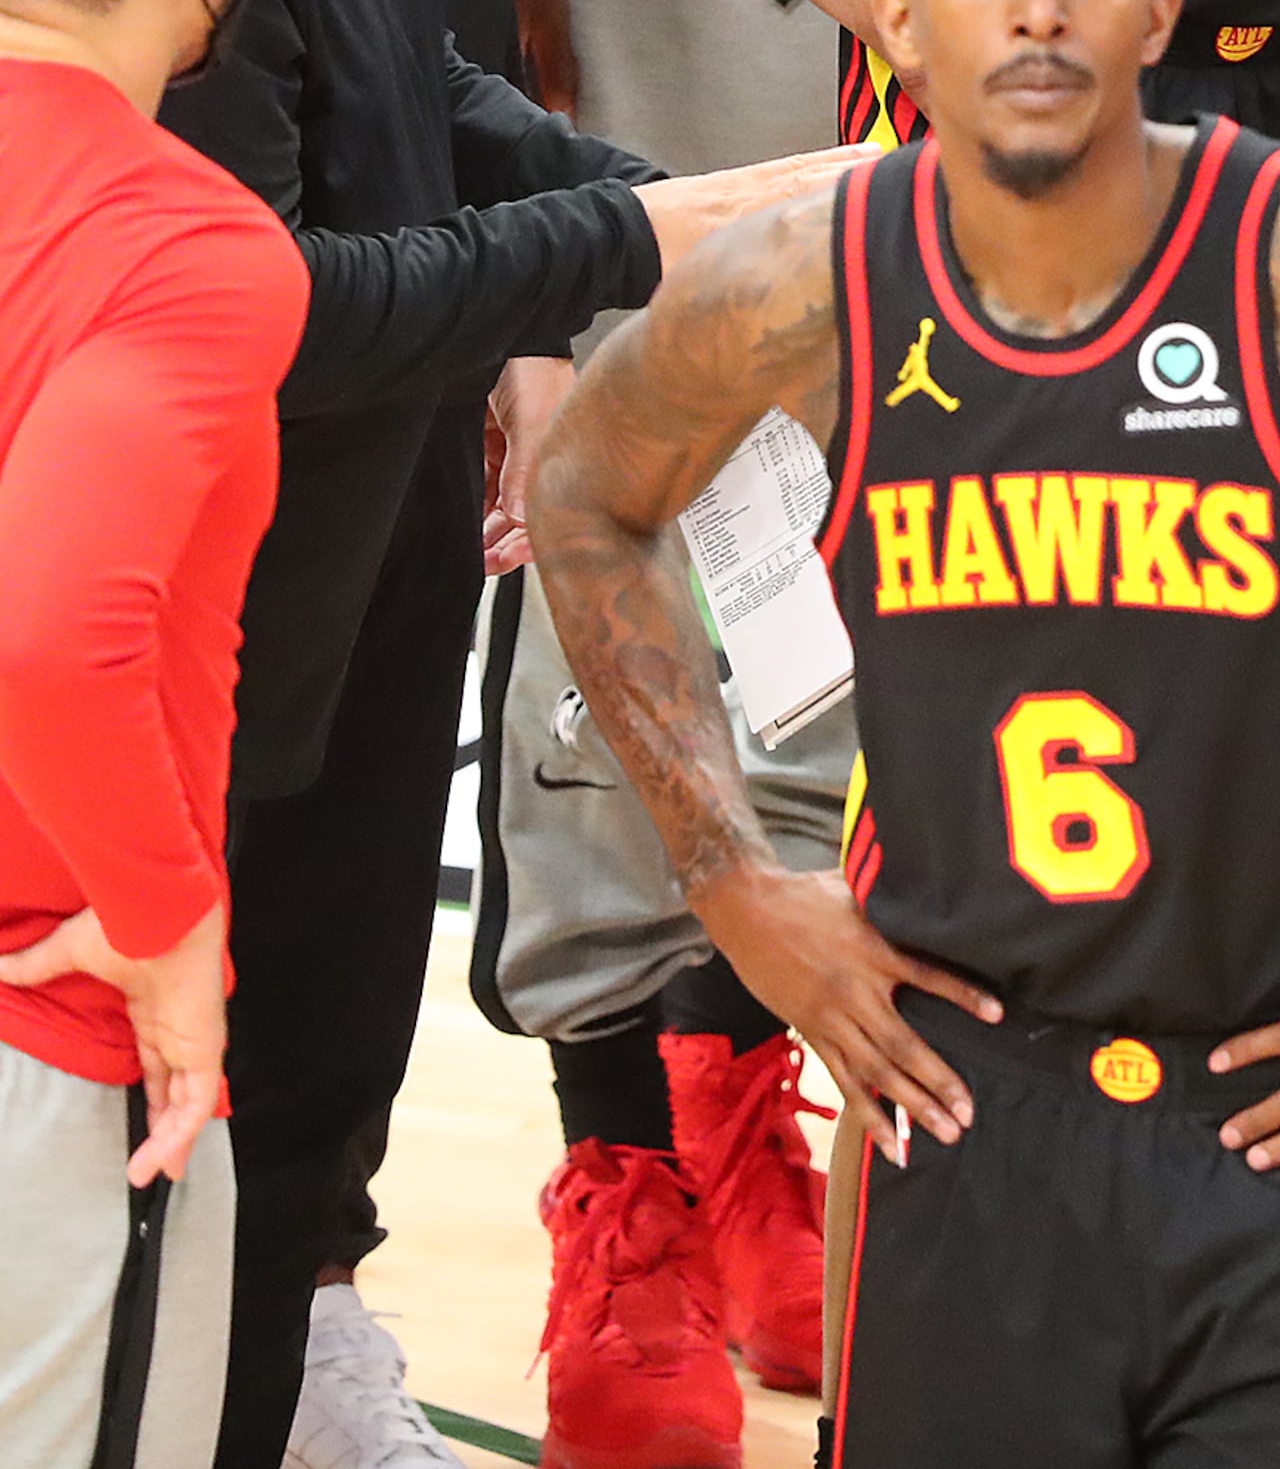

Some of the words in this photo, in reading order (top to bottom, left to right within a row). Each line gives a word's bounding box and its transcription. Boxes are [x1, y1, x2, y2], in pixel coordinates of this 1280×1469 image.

[1223, 26, 1264, 46] ATL
[1124, 406, 1240, 432] sharecare
[866, 470, 1280, 620] HAWKS
[993, 689, 1151, 903] 6
[1103, 1058, 1150, 1084] ATL
